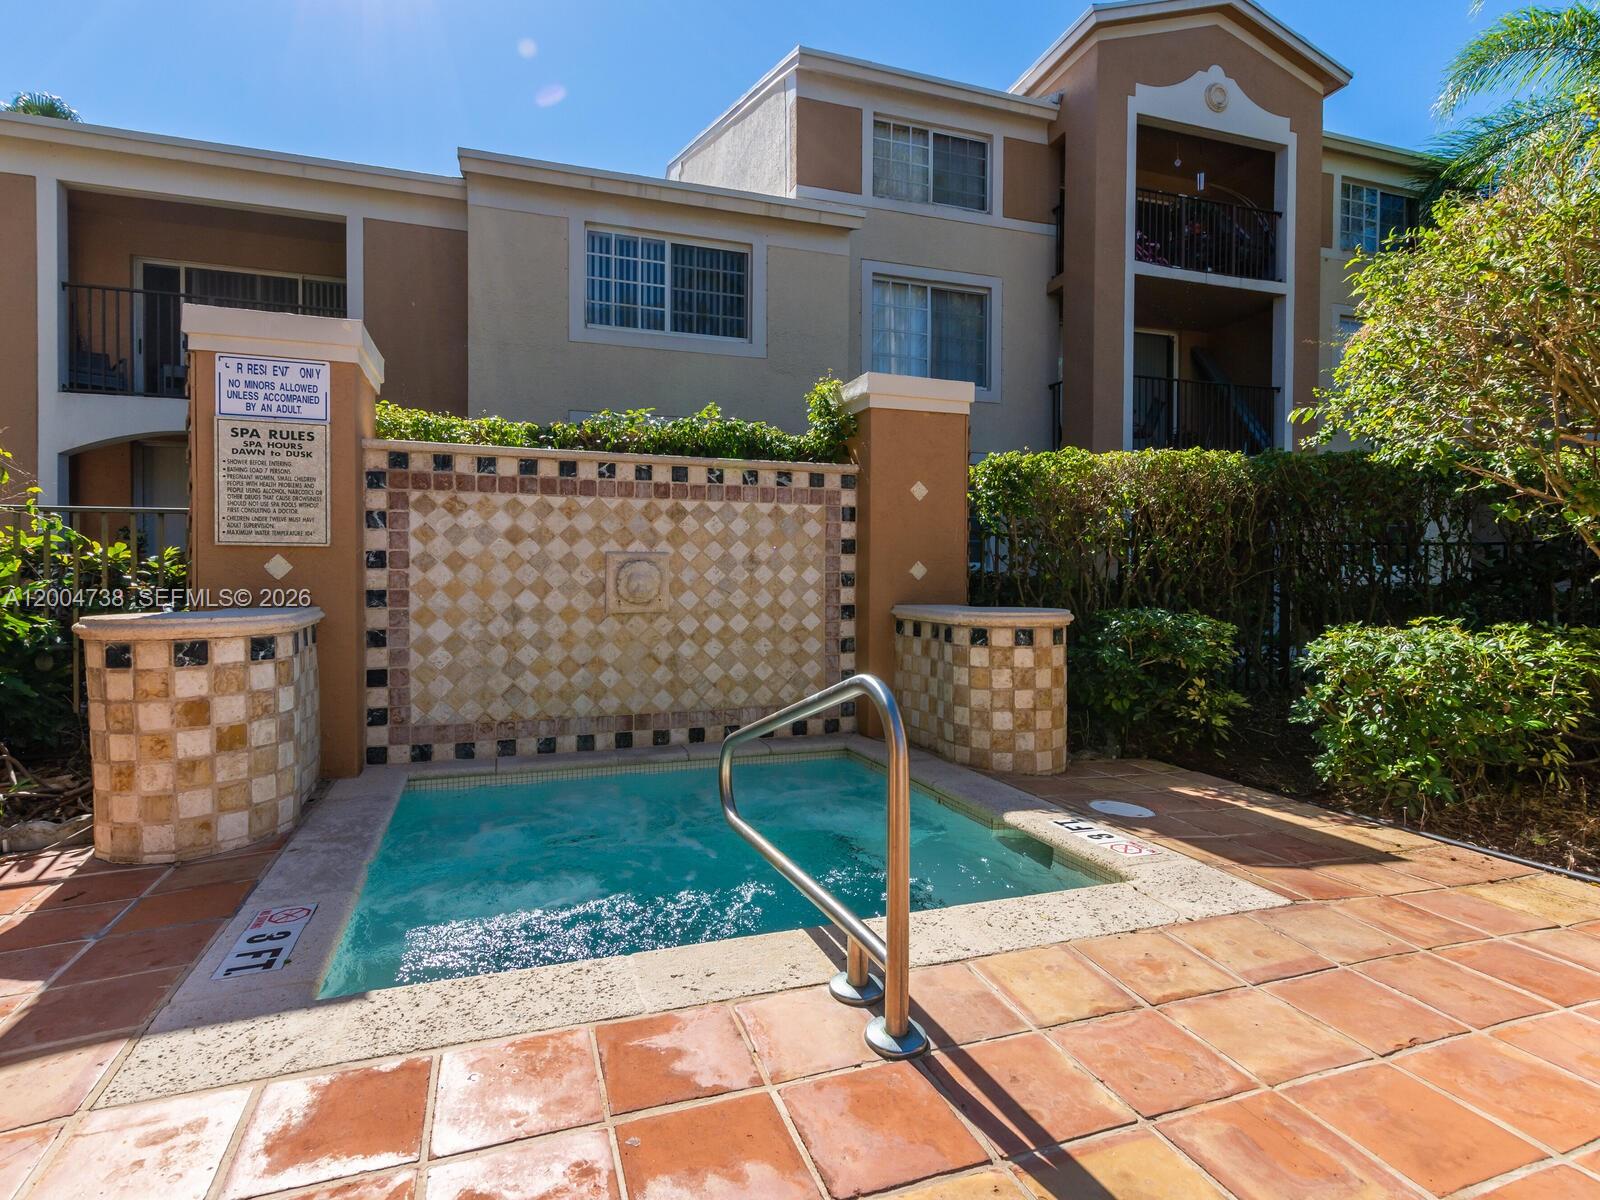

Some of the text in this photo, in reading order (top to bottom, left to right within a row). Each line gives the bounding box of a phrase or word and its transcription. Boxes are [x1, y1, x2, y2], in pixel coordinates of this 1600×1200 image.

[229, 379, 318, 393] NO MINORS ALLOWED
[227, 391, 319, 404] UNLESS ACCOMPANIED
[246, 403, 302, 414] BY AN ADULT.
[231, 428, 315, 441] SPA RULES
[247, 931, 291, 944] 3
[223, 947, 283, 976] FT.
